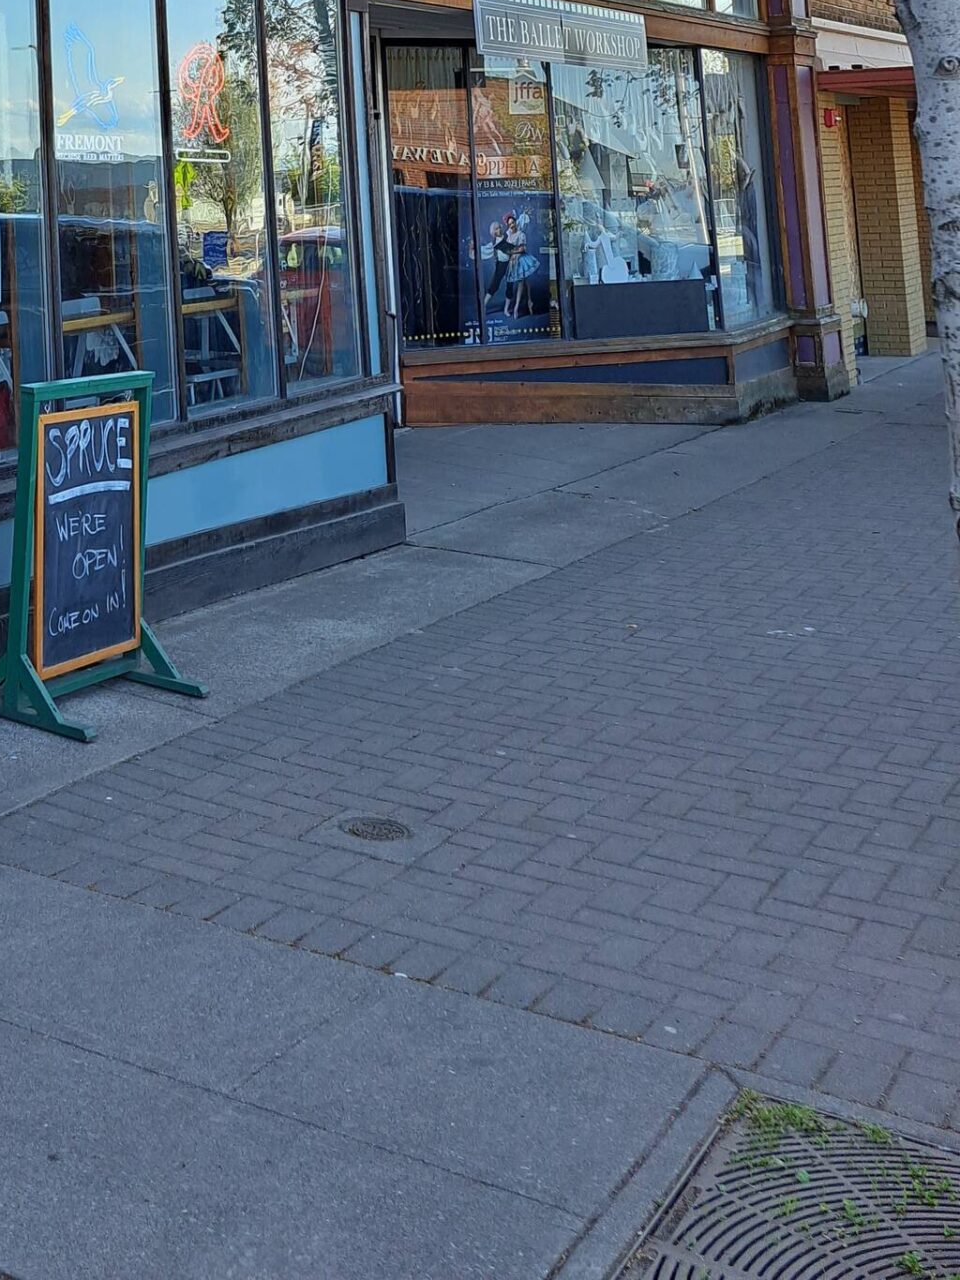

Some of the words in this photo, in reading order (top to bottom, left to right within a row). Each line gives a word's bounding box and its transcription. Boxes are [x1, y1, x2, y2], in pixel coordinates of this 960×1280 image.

[485, 15, 518, 43] THE
[520, 20, 571, 50] BALLET
[574, 28, 641, 59] WORKSHOP
[513, 81, 544, 104] jffa
[57, 134, 125, 151] FREMONT
[45, 418, 133, 487] SPRUCE
[55, 510, 107, 542] WE'RE
[48, 607, 80, 637] COME
[82, 603, 99, 624] ON
